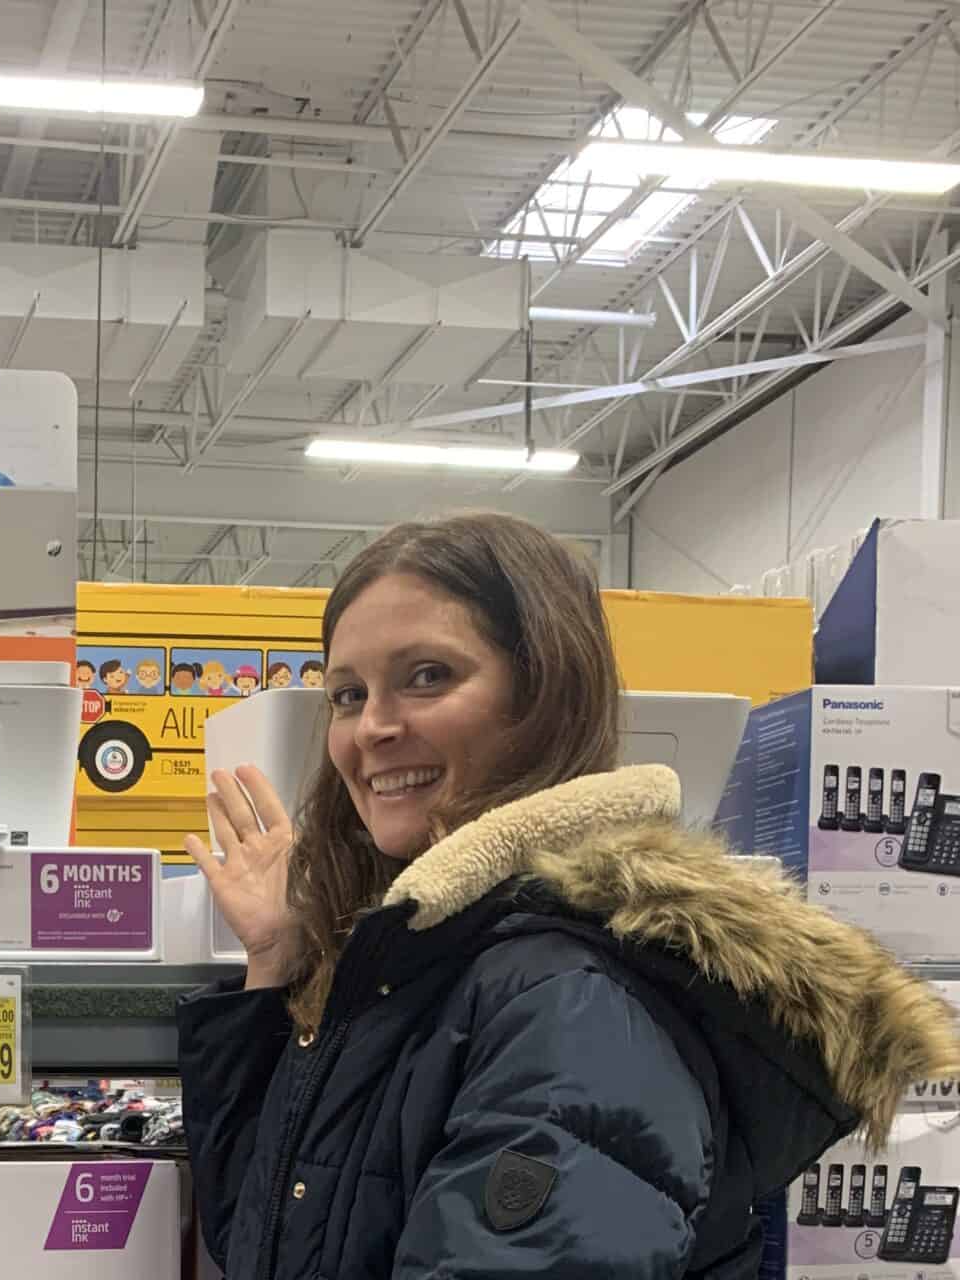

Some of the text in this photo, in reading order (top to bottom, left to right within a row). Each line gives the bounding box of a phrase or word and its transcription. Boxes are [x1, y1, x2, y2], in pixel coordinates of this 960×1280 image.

[83, 701, 100, 713] TOP
[822, 698, 884, 710] Panasonic
[160, 706, 209, 739] All-
[884, 840, 893, 855] 5
[40, 863, 142, 894] 6 MONTHS
[73, 885, 112, 899] instant
[75, 1172, 94, 1202] 6
[71, 1219, 109, 1233] instant
[864, 1233, 873, 1248] 5
